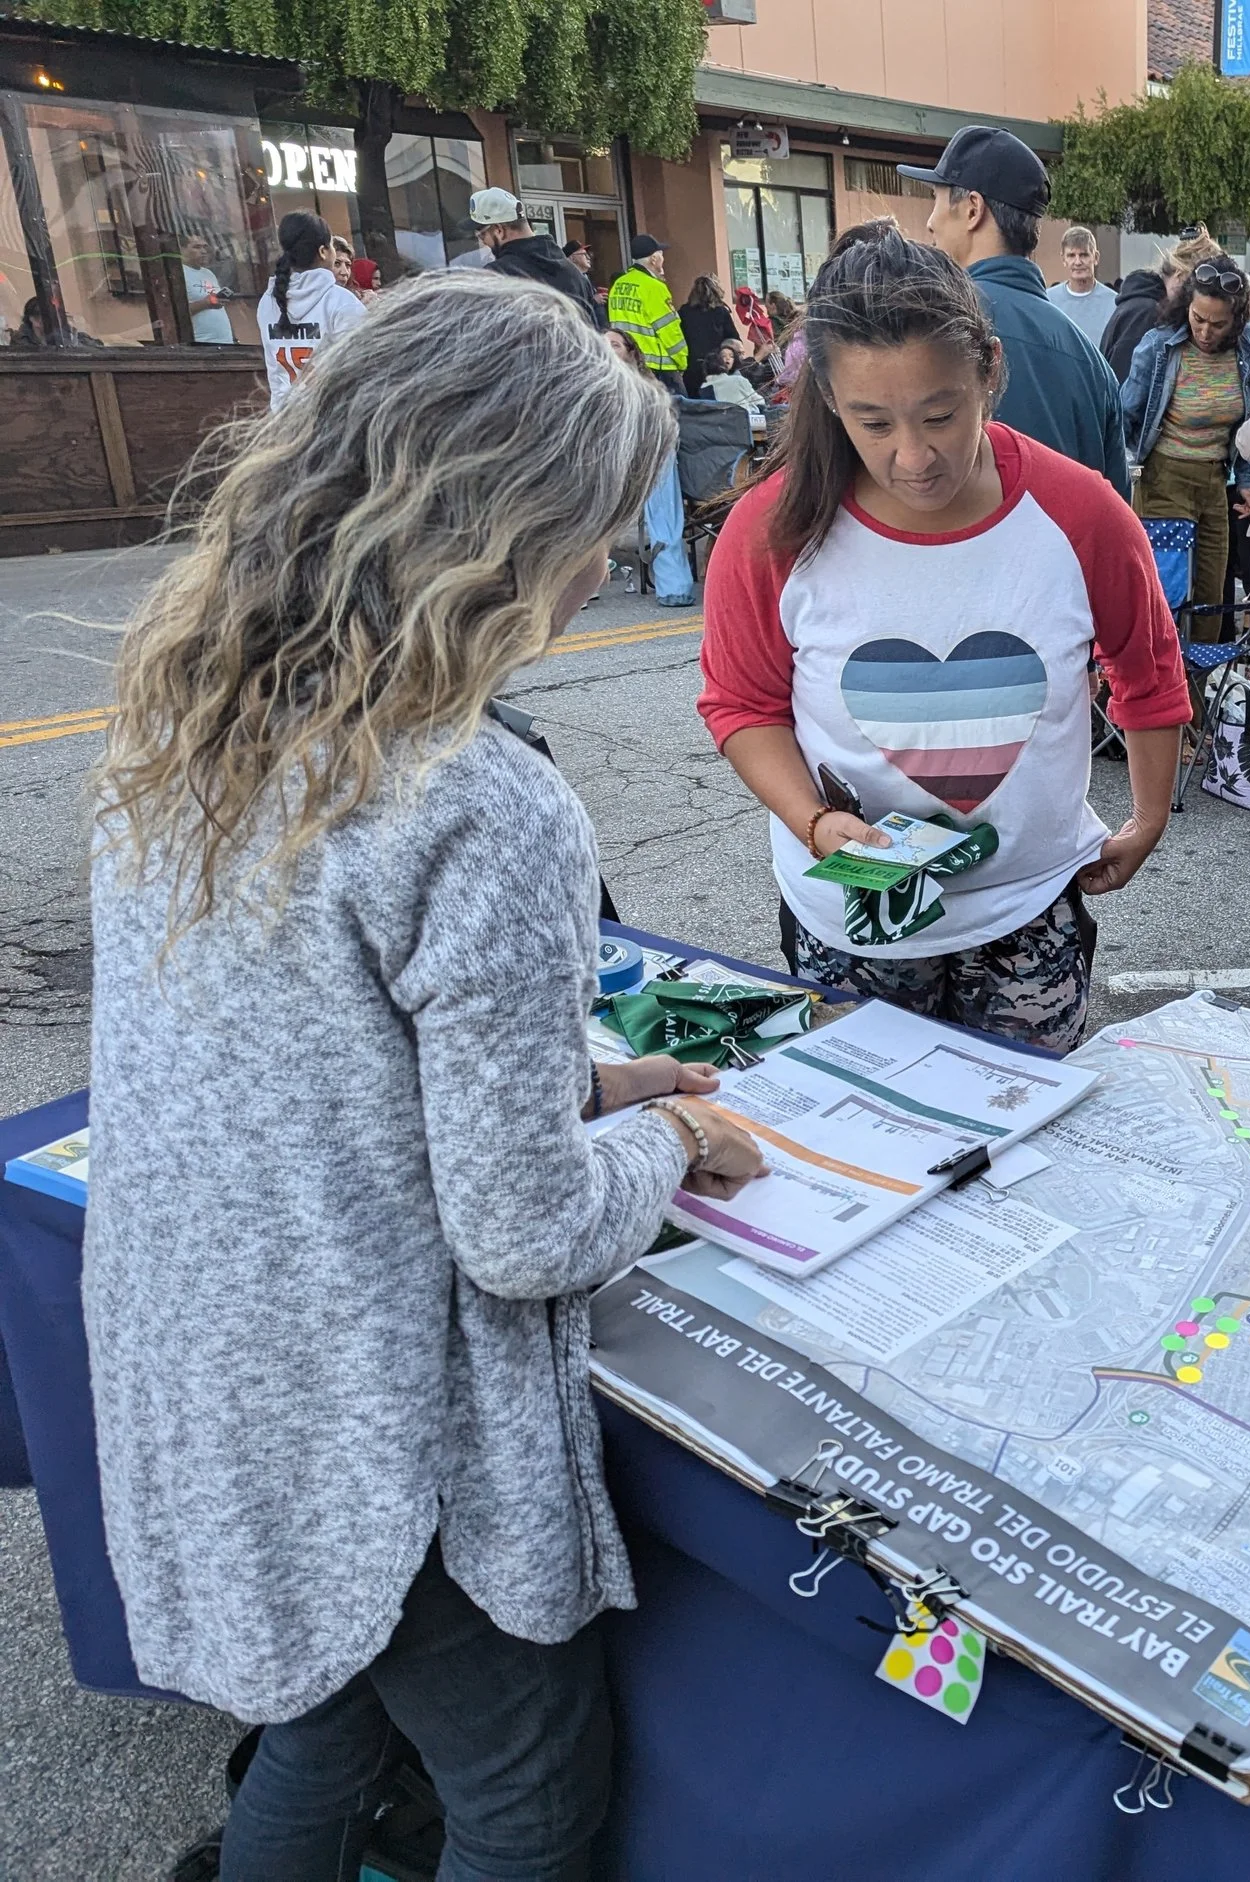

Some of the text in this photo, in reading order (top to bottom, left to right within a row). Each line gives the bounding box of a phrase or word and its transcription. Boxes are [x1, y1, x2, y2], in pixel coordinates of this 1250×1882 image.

[1236, 5, 1244, 60] MILLBRAE
[1087, 1135, 1183, 1176] INTERNATIONAL
[1103, 1149, 1130, 1165] SAN
[629, 1287, 696, 1334] TRAIL
[682, 1321, 742, 1359] BAY
[735, 1344, 787, 1382] DEL
[775, 1369, 903, 1462] FALTANTE
[816, 1444, 913, 1513] STUDY
[896, 1454, 994, 1514] TRAMO
[1054, 1458, 1077, 1477] 101
[906, 1498, 972, 1543] GAP
[991, 1503, 1050, 1550] DEL
[969, 1535, 1034, 1585] SFO
[1045, 1542, 1175, 1621] ESTUDIO
[1033, 1572, 1121, 1637] TRAIL
[1175, 1609, 1214, 1643] EL
[1116, 1626, 1190, 1677] BAY
